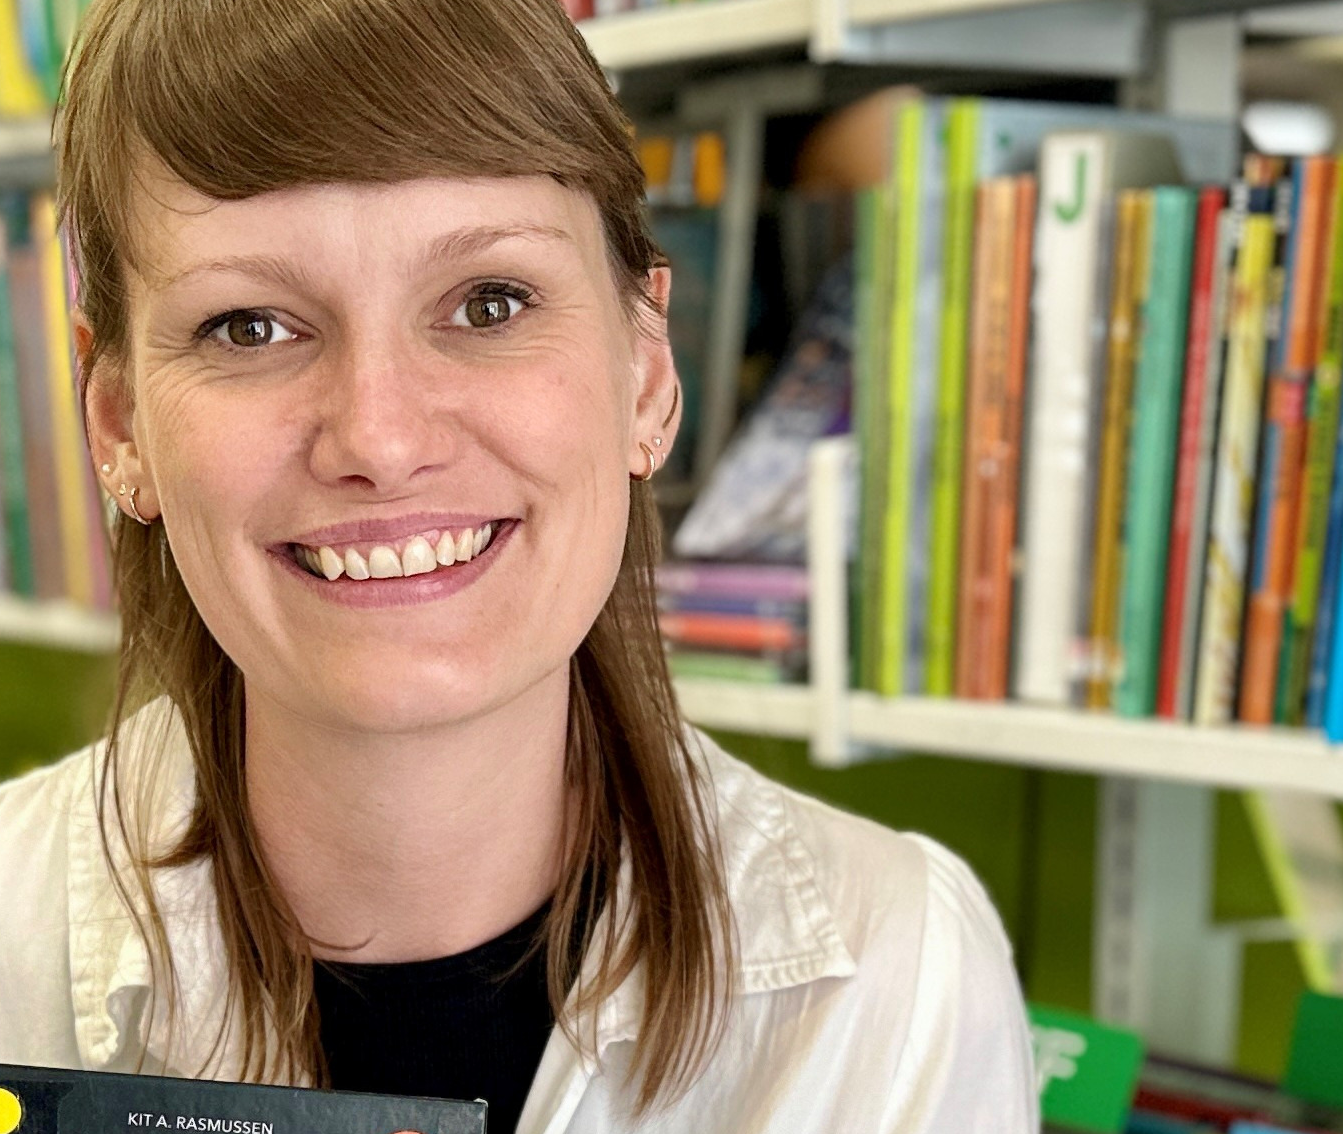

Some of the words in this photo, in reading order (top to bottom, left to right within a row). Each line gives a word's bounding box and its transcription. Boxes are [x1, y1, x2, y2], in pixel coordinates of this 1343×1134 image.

[1055, 153, 1087, 223] J
[128, 1112, 153, 1128] KIT
[156, 1114, 172, 1130] A.
